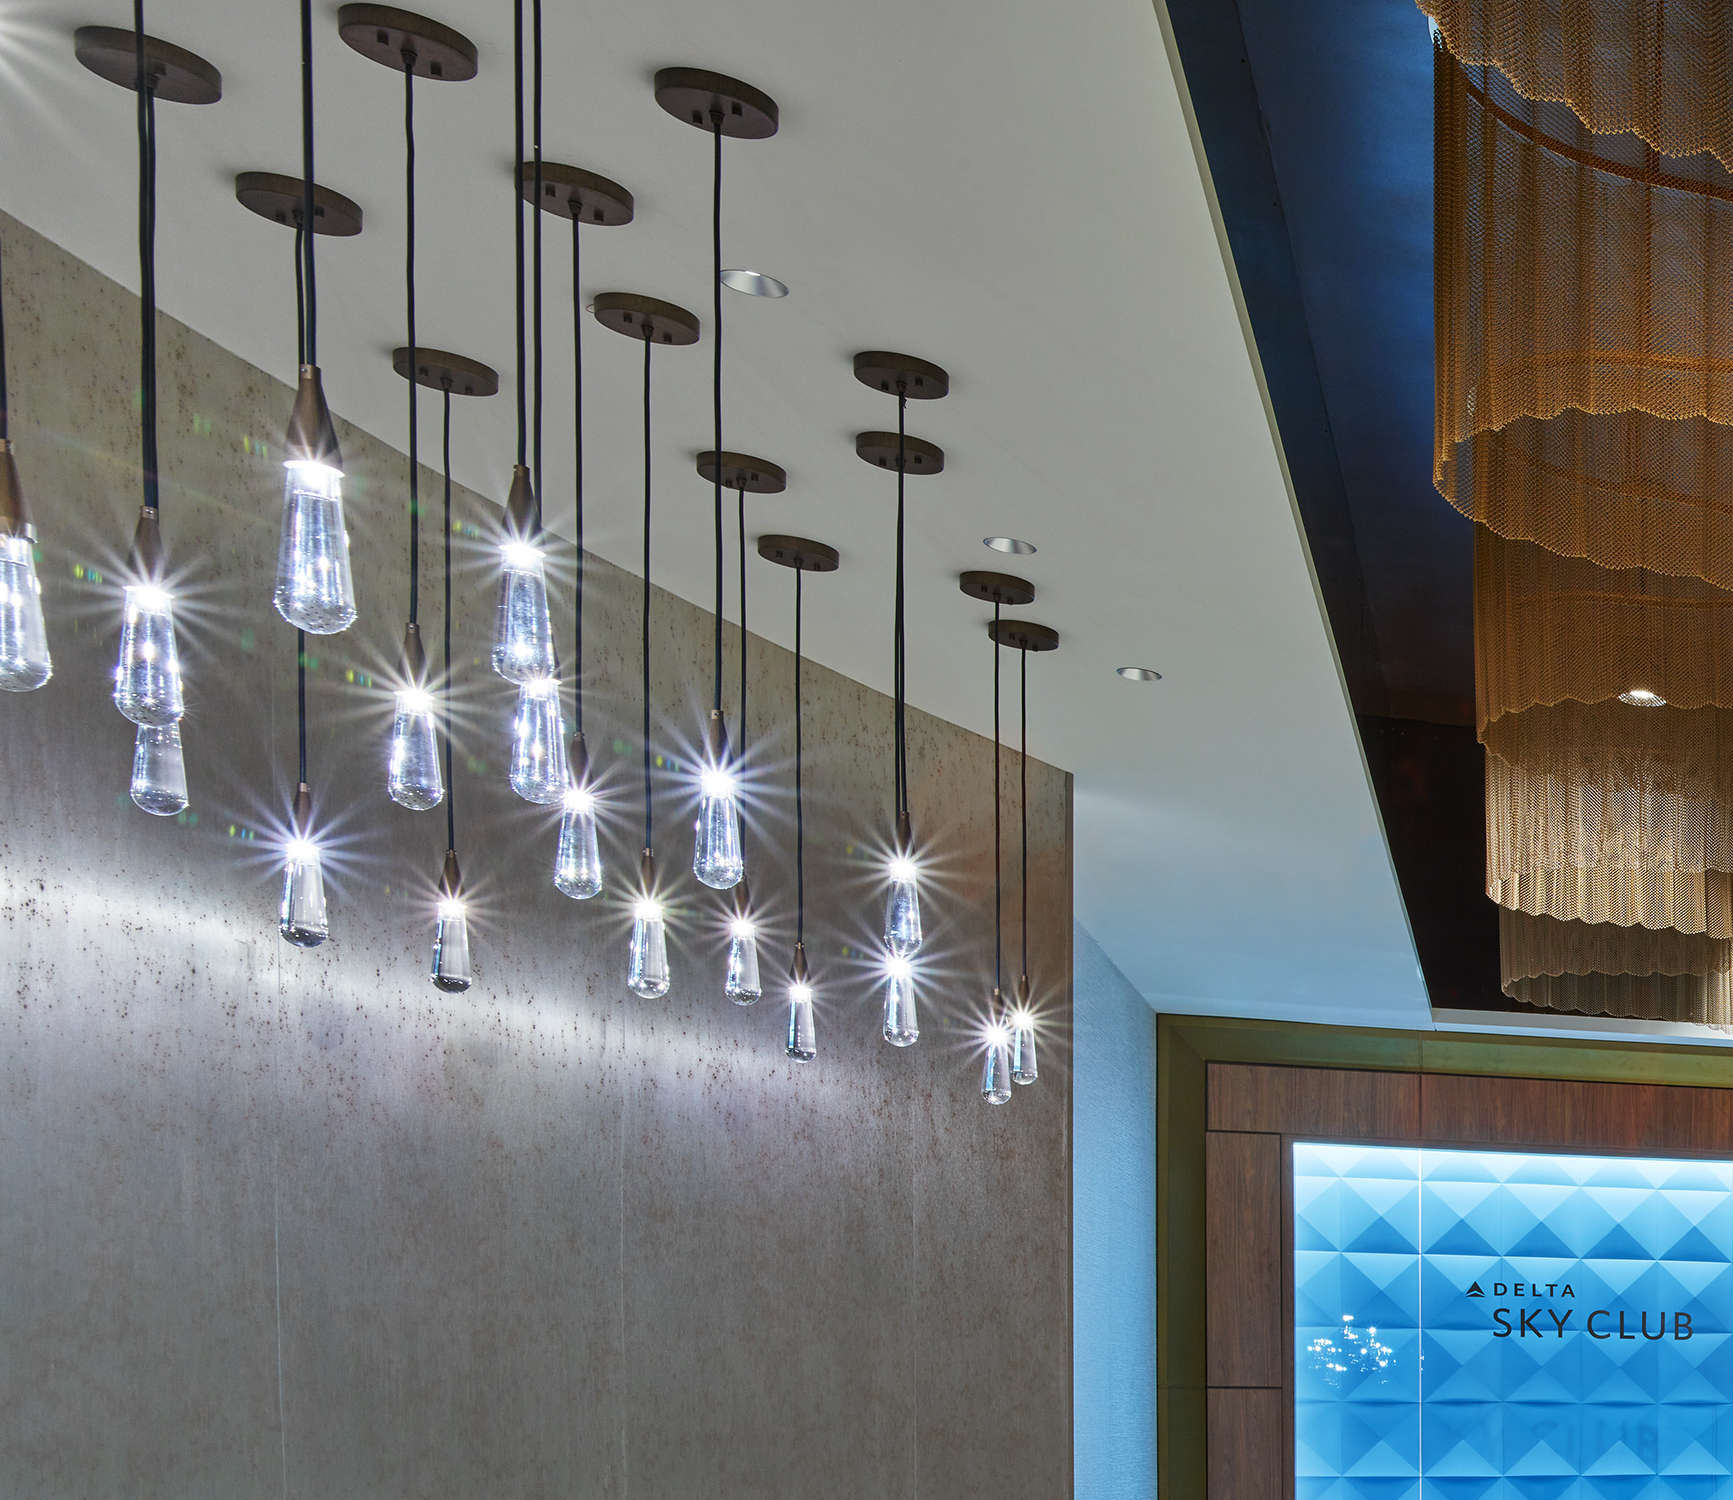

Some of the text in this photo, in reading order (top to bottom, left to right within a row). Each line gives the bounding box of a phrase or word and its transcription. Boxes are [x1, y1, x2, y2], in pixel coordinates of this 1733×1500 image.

[1494, 1282, 1576, 1298] DELTA
[1492, 1307, 1694, 1341] SKY CLUB
